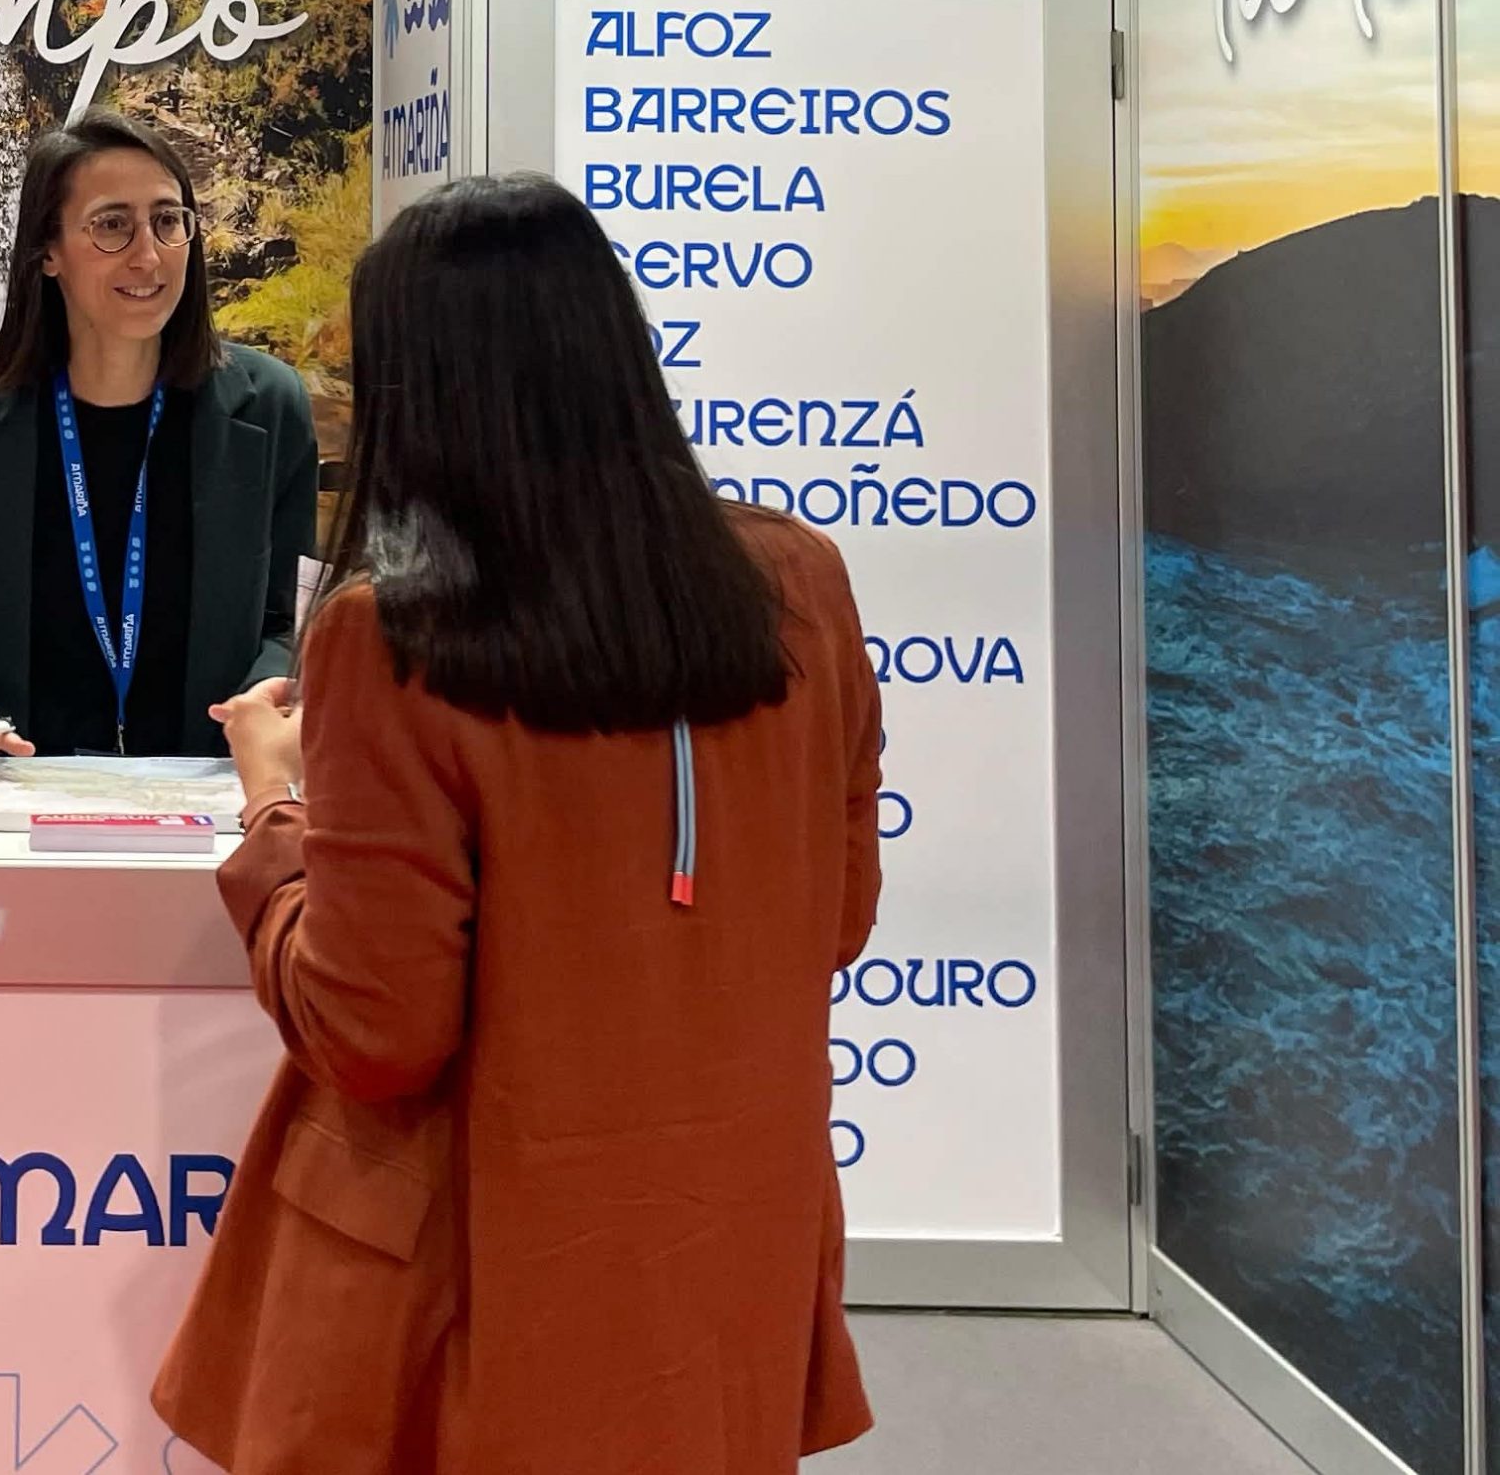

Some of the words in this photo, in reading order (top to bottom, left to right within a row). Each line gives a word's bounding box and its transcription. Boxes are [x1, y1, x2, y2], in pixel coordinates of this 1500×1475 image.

[585, 9, 772, 59] ALFOZ
[584, 85, 951, 136] BARREIROS
[584, 162, 826, 213] BURELA
